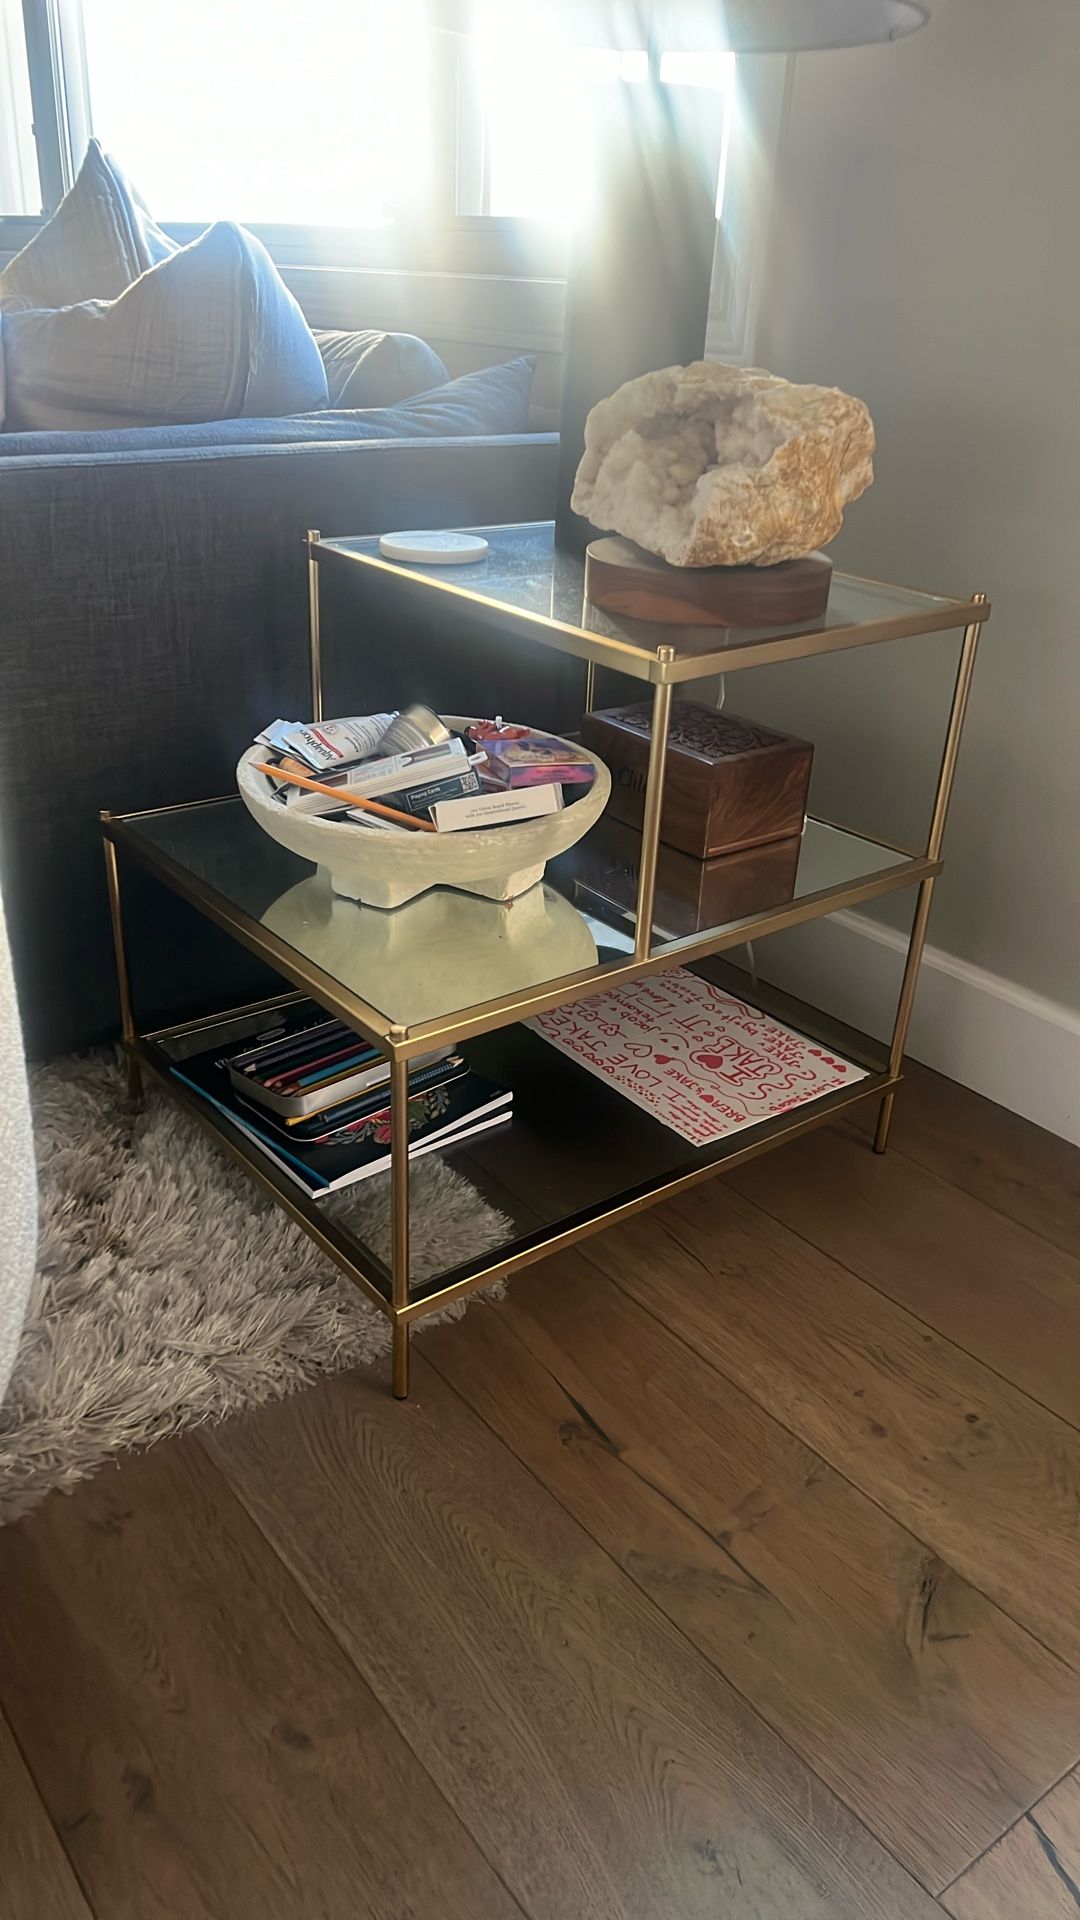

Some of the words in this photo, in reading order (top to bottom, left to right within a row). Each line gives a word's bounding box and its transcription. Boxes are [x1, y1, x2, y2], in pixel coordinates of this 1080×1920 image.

[411, 792, 428, 800] Playing
[427, 787, 441, 796] Cards
[549, 1014, 608, 1051] JAKE
[766, 1027, 804, 1048] JAKE
[708, 1038, 774, 1077] JAKE
[763, 1036, 802, 1058] JAKE
[763, 1045, 799, 1066] JAKE
[606, 1053, 663, 1087] LOVE
[719, 1065, 752, 1083] I
[662, 1086, 687, 1103] I
